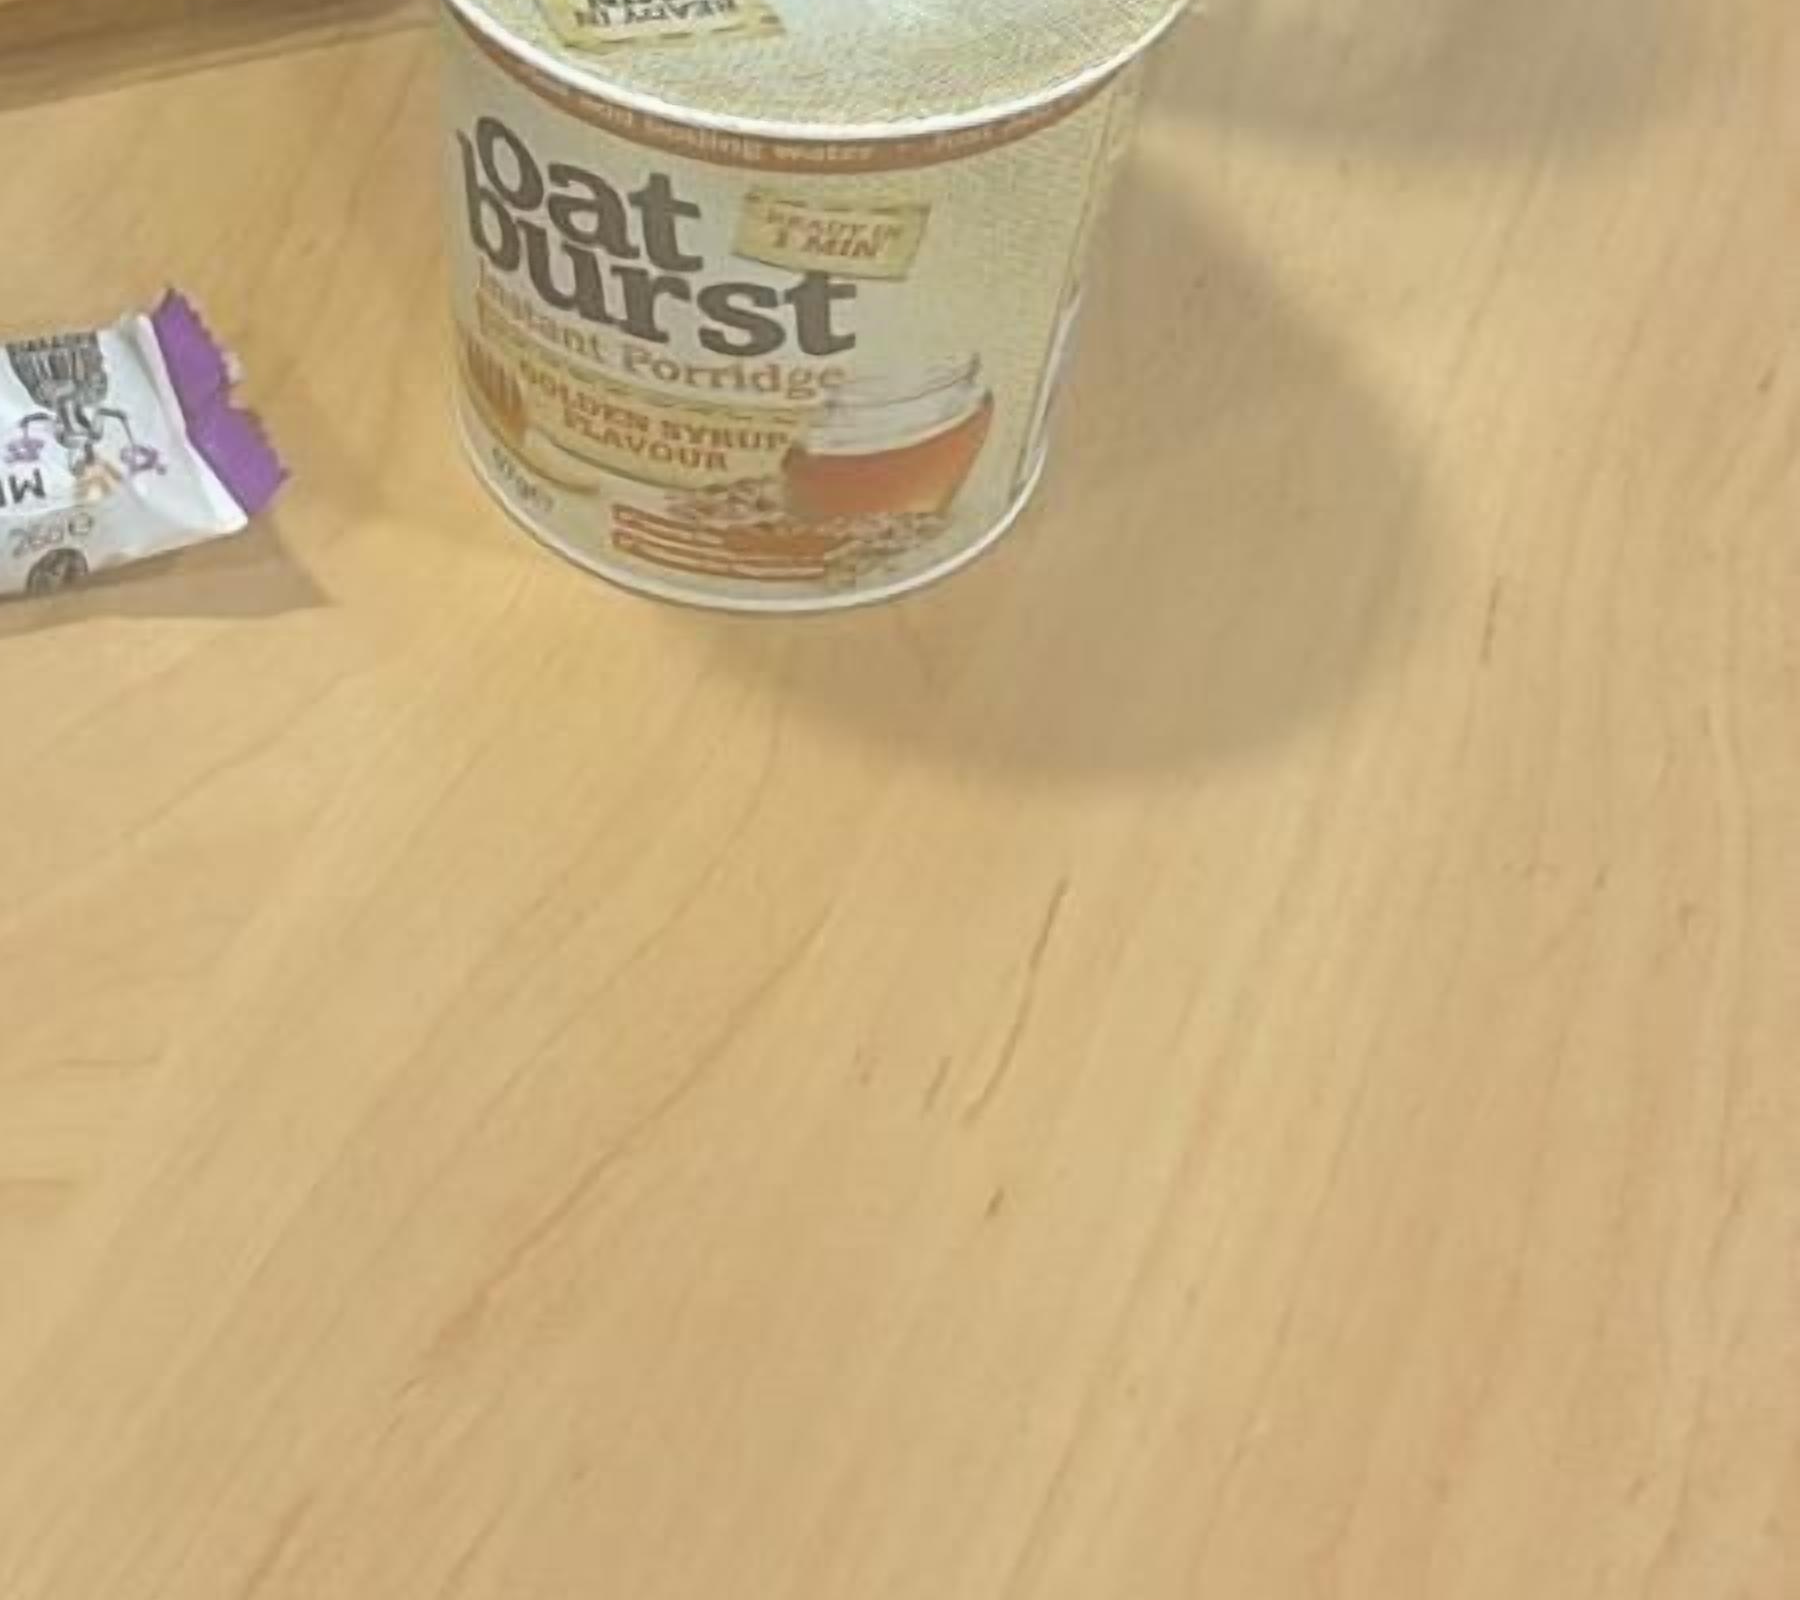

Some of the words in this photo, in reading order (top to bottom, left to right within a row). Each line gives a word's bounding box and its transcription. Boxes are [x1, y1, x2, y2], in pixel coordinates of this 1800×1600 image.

[474, 115, 704, 273] oat
[456, 129, 858, 357] burst
[802, 235, 880, 258] MIN
[622, 342, 848, 400] Porridge
[563, 404, 730, 471] FLAVOUR
[661, 417, 792, 452] SYRUP
